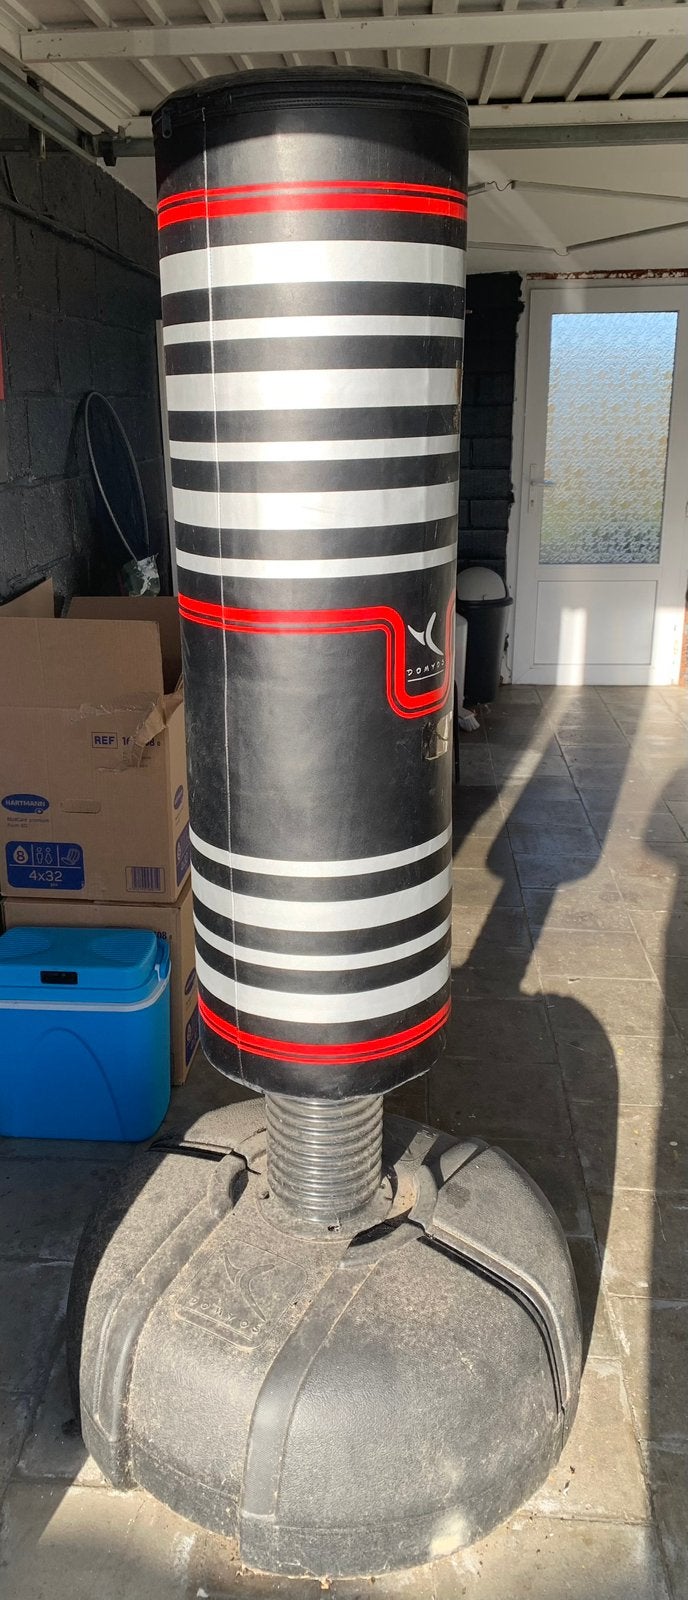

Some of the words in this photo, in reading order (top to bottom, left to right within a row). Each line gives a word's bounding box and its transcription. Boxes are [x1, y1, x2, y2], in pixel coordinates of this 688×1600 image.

[406, 659, 445, 676] DOMYOS
[94, 735, 115, 745] REF
[5, 799, 46, 807] HARTMANN
[16, 850, 25, 861] 8
[29, 869, 63, 882] 4x32
